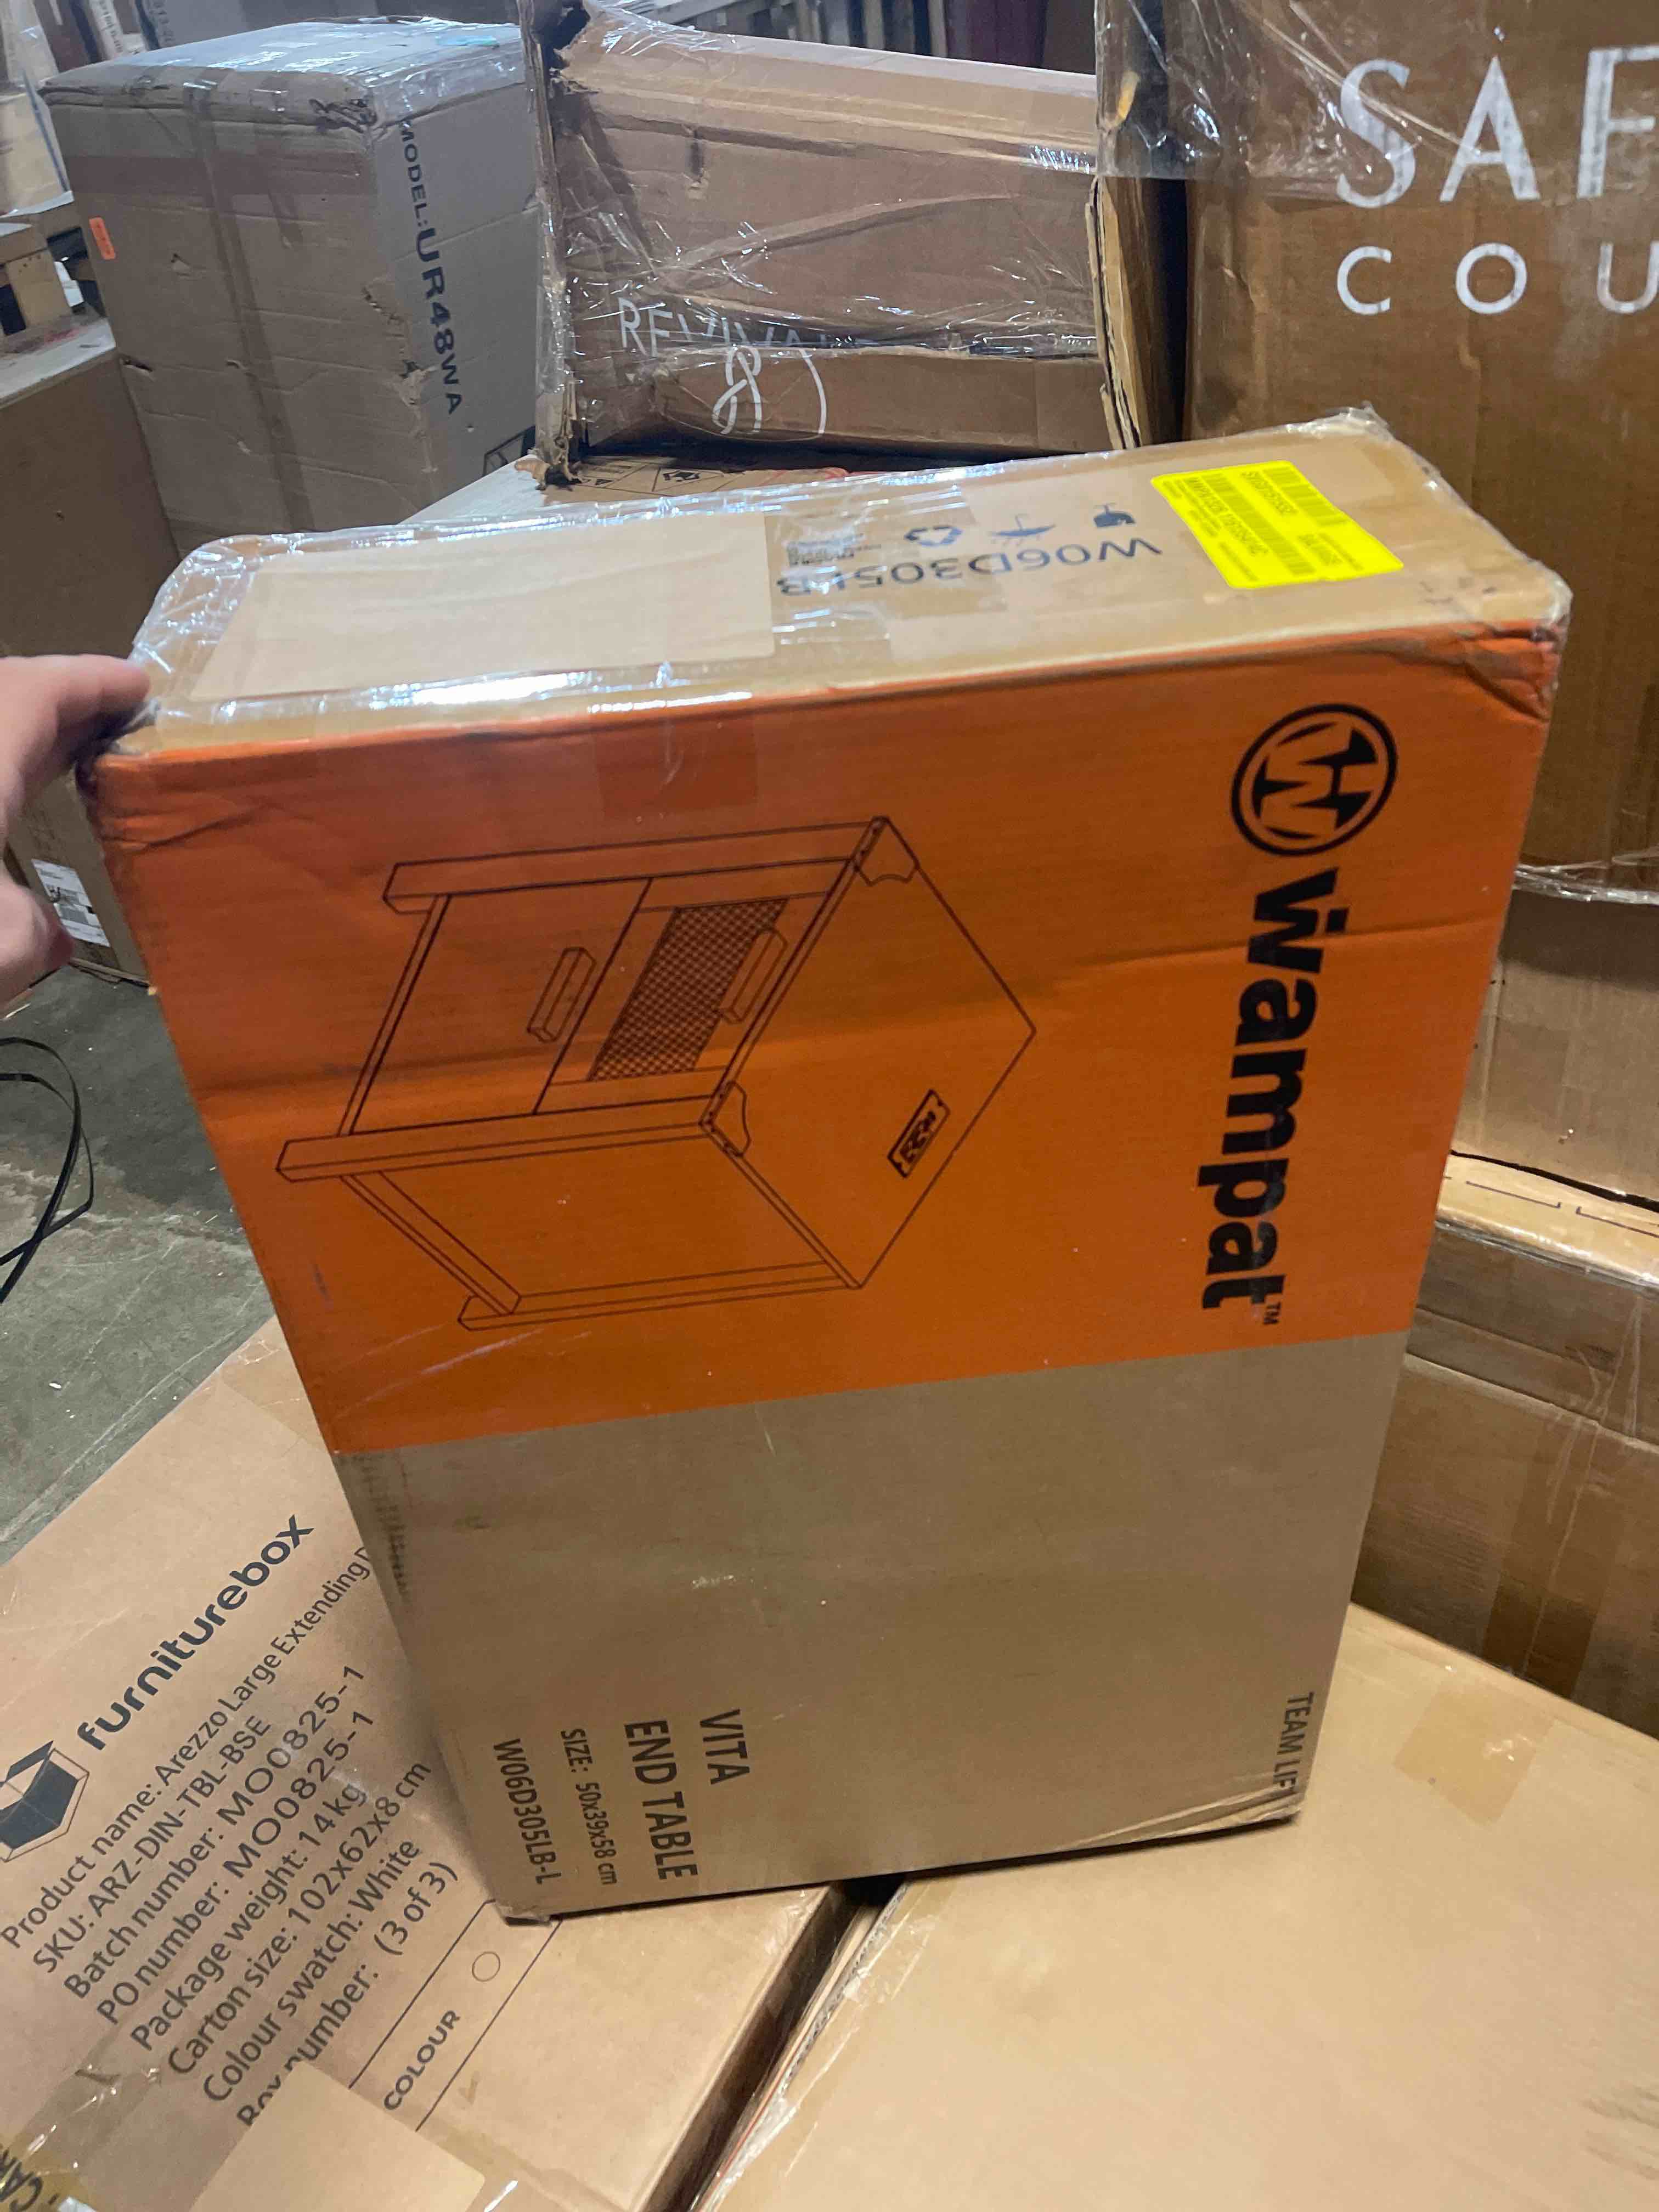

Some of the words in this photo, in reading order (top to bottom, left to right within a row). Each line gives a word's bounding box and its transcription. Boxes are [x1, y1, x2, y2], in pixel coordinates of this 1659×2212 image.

[1336, 242, 1659, 315] COU
[77, 1514, 314, 1751] furniturebox
[0, 1855, 96, 1949] Product
[91, 1784, 162, 1855] name:
[155, 1711, 228, 1786] Arezzo
[217, 1654, 281, 1712] Large
[270, 1562, 370, 1655] Extending
[561, 1729, 593, 1773] SIZE:
[624, 1720, 677, 1785] END
[699, 1709, 750, 1785] VITA
[1277, 1692, 1314, 1755] TEAM
[33, 1915, 94, 1973] SKU:
[88, 1715, 272, 1917] ARZ-DIN-TBL-BSE
[493, 1738, 562, 1885] W06D305LB-L
[575, 1782, 617, 1858] 50x39x58
[642, 1791, 698, 1880] TABLE
[64, 1925, 139, 1998] Batch
[132, 1827, 224, 1928] number:
[168, 1985, 251, 2074] Carton
[245, 1927, 297, 1988] size:
[288, 1796, 400, 1925] 102x62x8
[395, 1763, 432, 1798] cm
[374, 1920, 409, 1955] (3
[403, 1887, 431, 1922] of
[419, 1862, 458, 1894] 3)
[598, 1863, 617, 1884] cm
[97, 1982, 139, 2025] PO
[134, 1882, 229, 1986] number:
[130, 1943, 232, 2051] Package
[224, 1849, 309, 1941] weight:
[203, 2012, 281, 2101] Colour
[278, 1913, 364, 2017] swatch:
[347, 1840, 421, 1912] White
[383, 2010, 460, 2111] COLOUR
